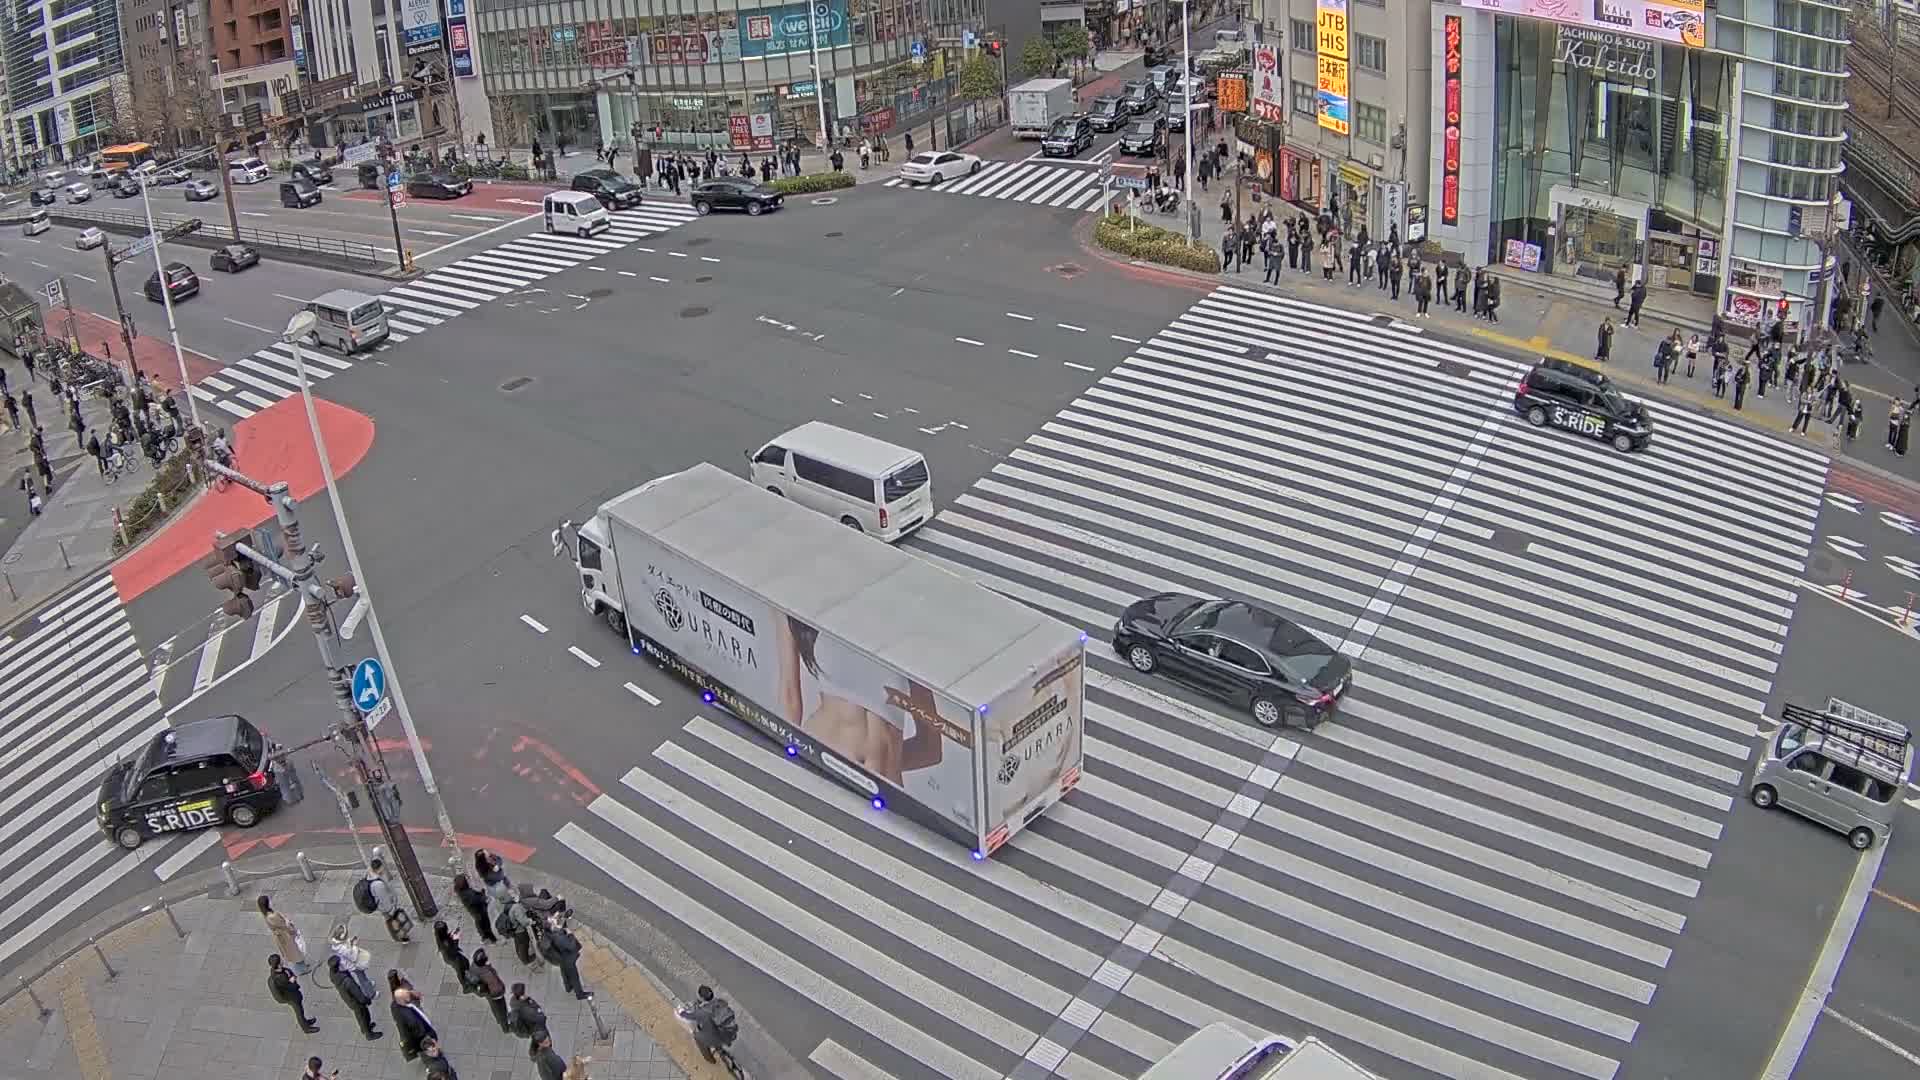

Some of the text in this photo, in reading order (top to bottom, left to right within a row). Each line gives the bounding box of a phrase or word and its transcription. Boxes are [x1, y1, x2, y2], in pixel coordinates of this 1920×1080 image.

[1319, 12, 1345, 31] JTB
[1320, 31, 1345, 51] HIS
[1557, 26, 1613, 45] PACHINKO
[1625, 38, 1652, 51] SLOT
[1320, 58, 1345, 80] 日本旅行
[1552, 38, 1657, 80] Kaleido
[1554, 411, 1605, 438] S.RIDE
[147, 807, 220, 834] S.RIDE
